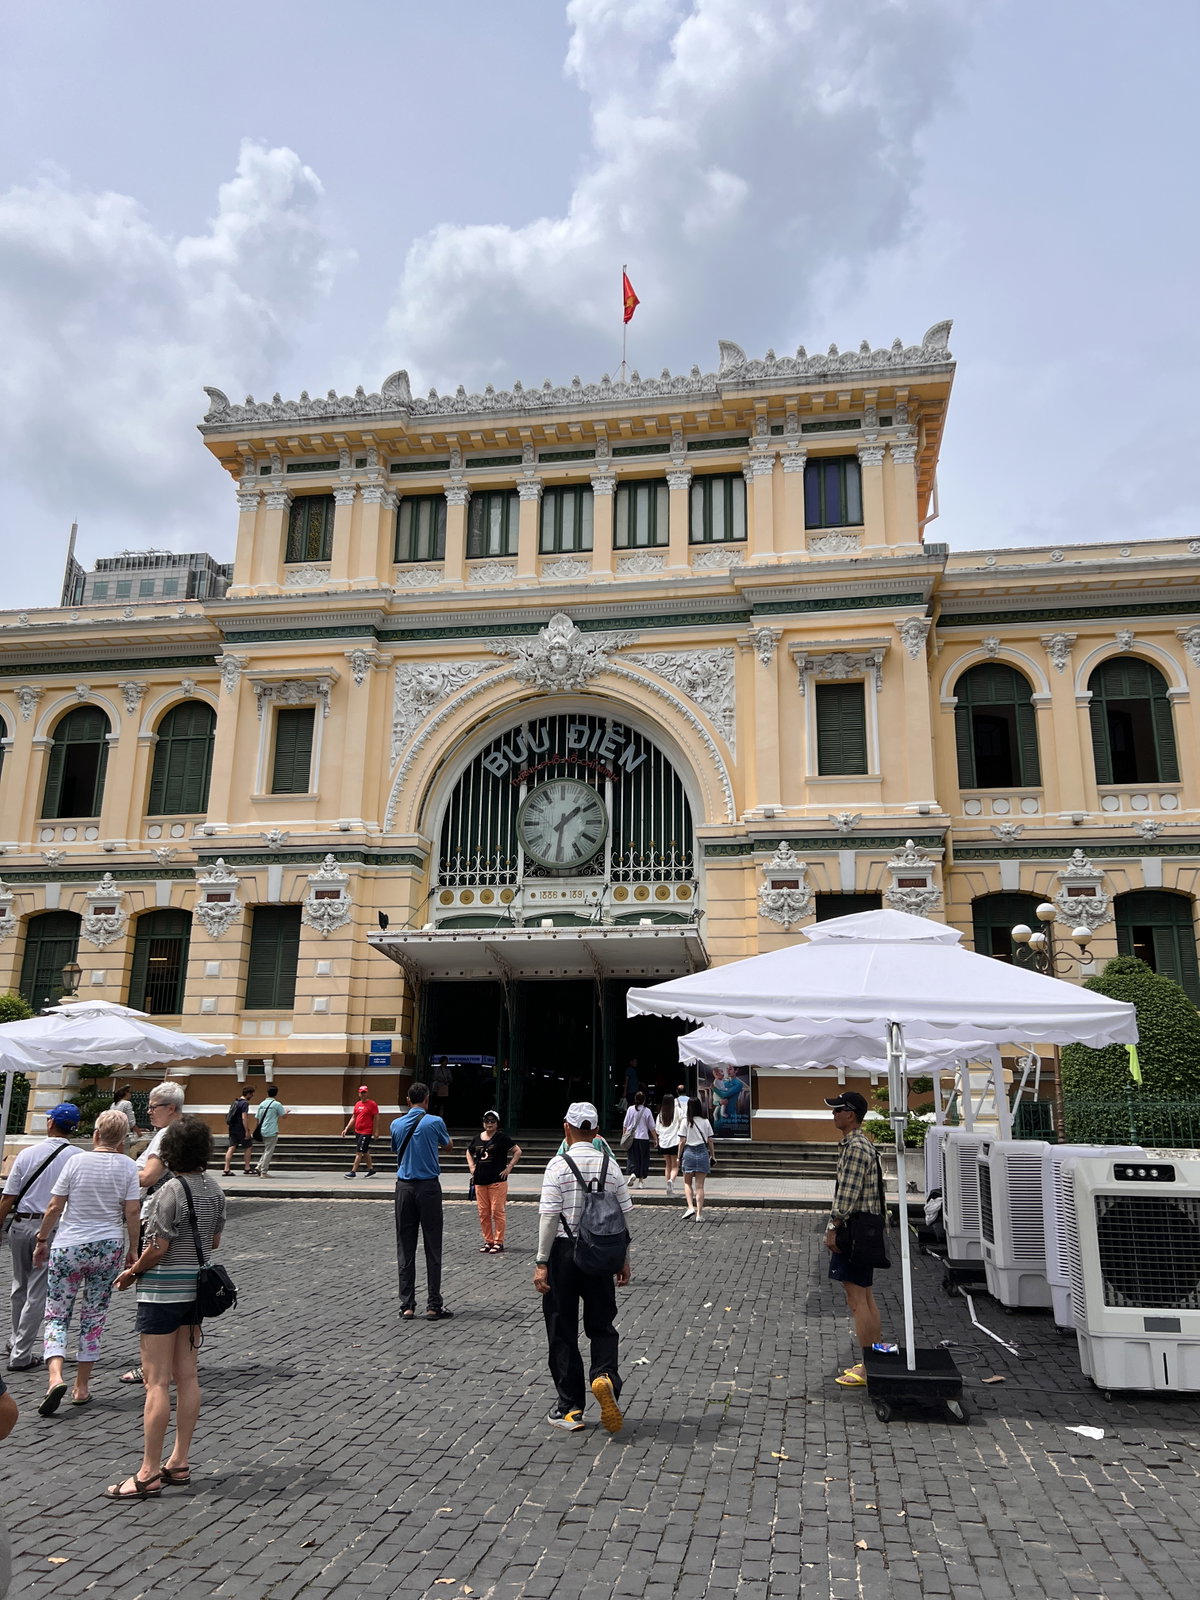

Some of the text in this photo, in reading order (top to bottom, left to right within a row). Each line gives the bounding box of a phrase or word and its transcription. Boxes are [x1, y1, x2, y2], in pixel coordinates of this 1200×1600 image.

[483, 724, 648, 778] BƯU ĐIỆN
[597, 765, 620, 783] MINH
